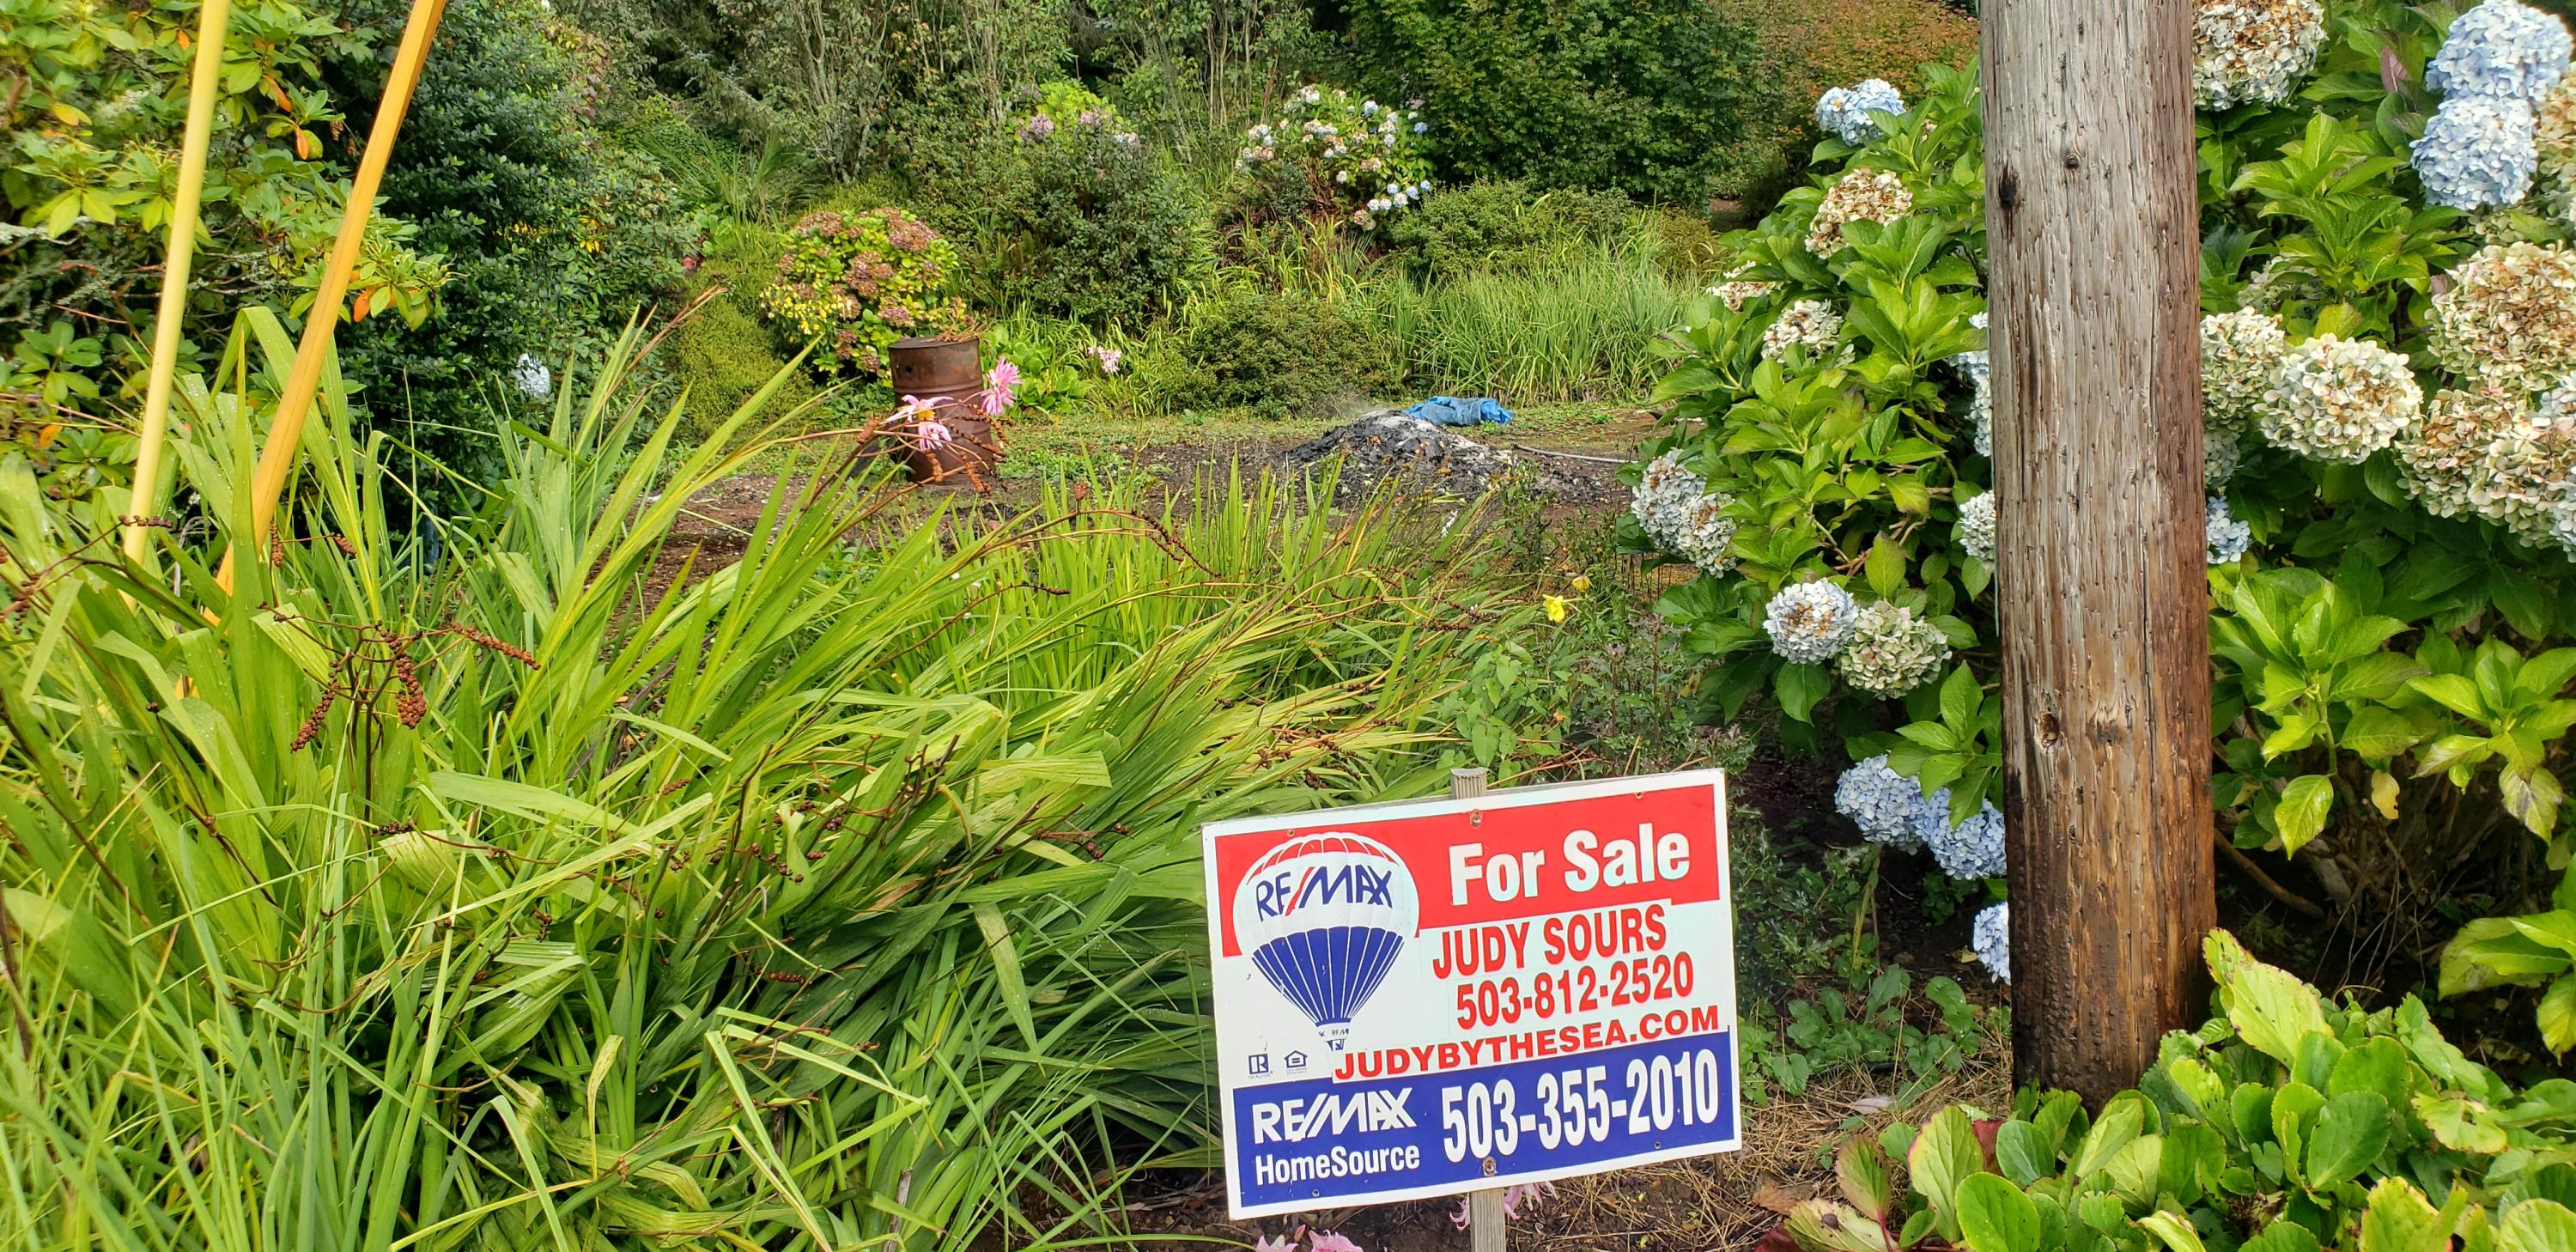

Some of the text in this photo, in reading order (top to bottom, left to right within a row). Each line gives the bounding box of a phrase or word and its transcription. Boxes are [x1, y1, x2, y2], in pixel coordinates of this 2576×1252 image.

[1256, 865, 1393, 921] RE/MAX
[1450, 823, 1690, 906] For Sale
[1432, 904, 1667, 979] JUDY SOURS
[1456, 951, 1694, 1030] 503-812-2520
[1334, 1005, 1719, 1080] JUDYBYTHESEA.COM
[1252, 1087, 1417, 1145] RE/MAX
[1443, 1048, 1718, 1163] 503-355-2010
[1255, 1145, 1420, 1186] HomeSource
